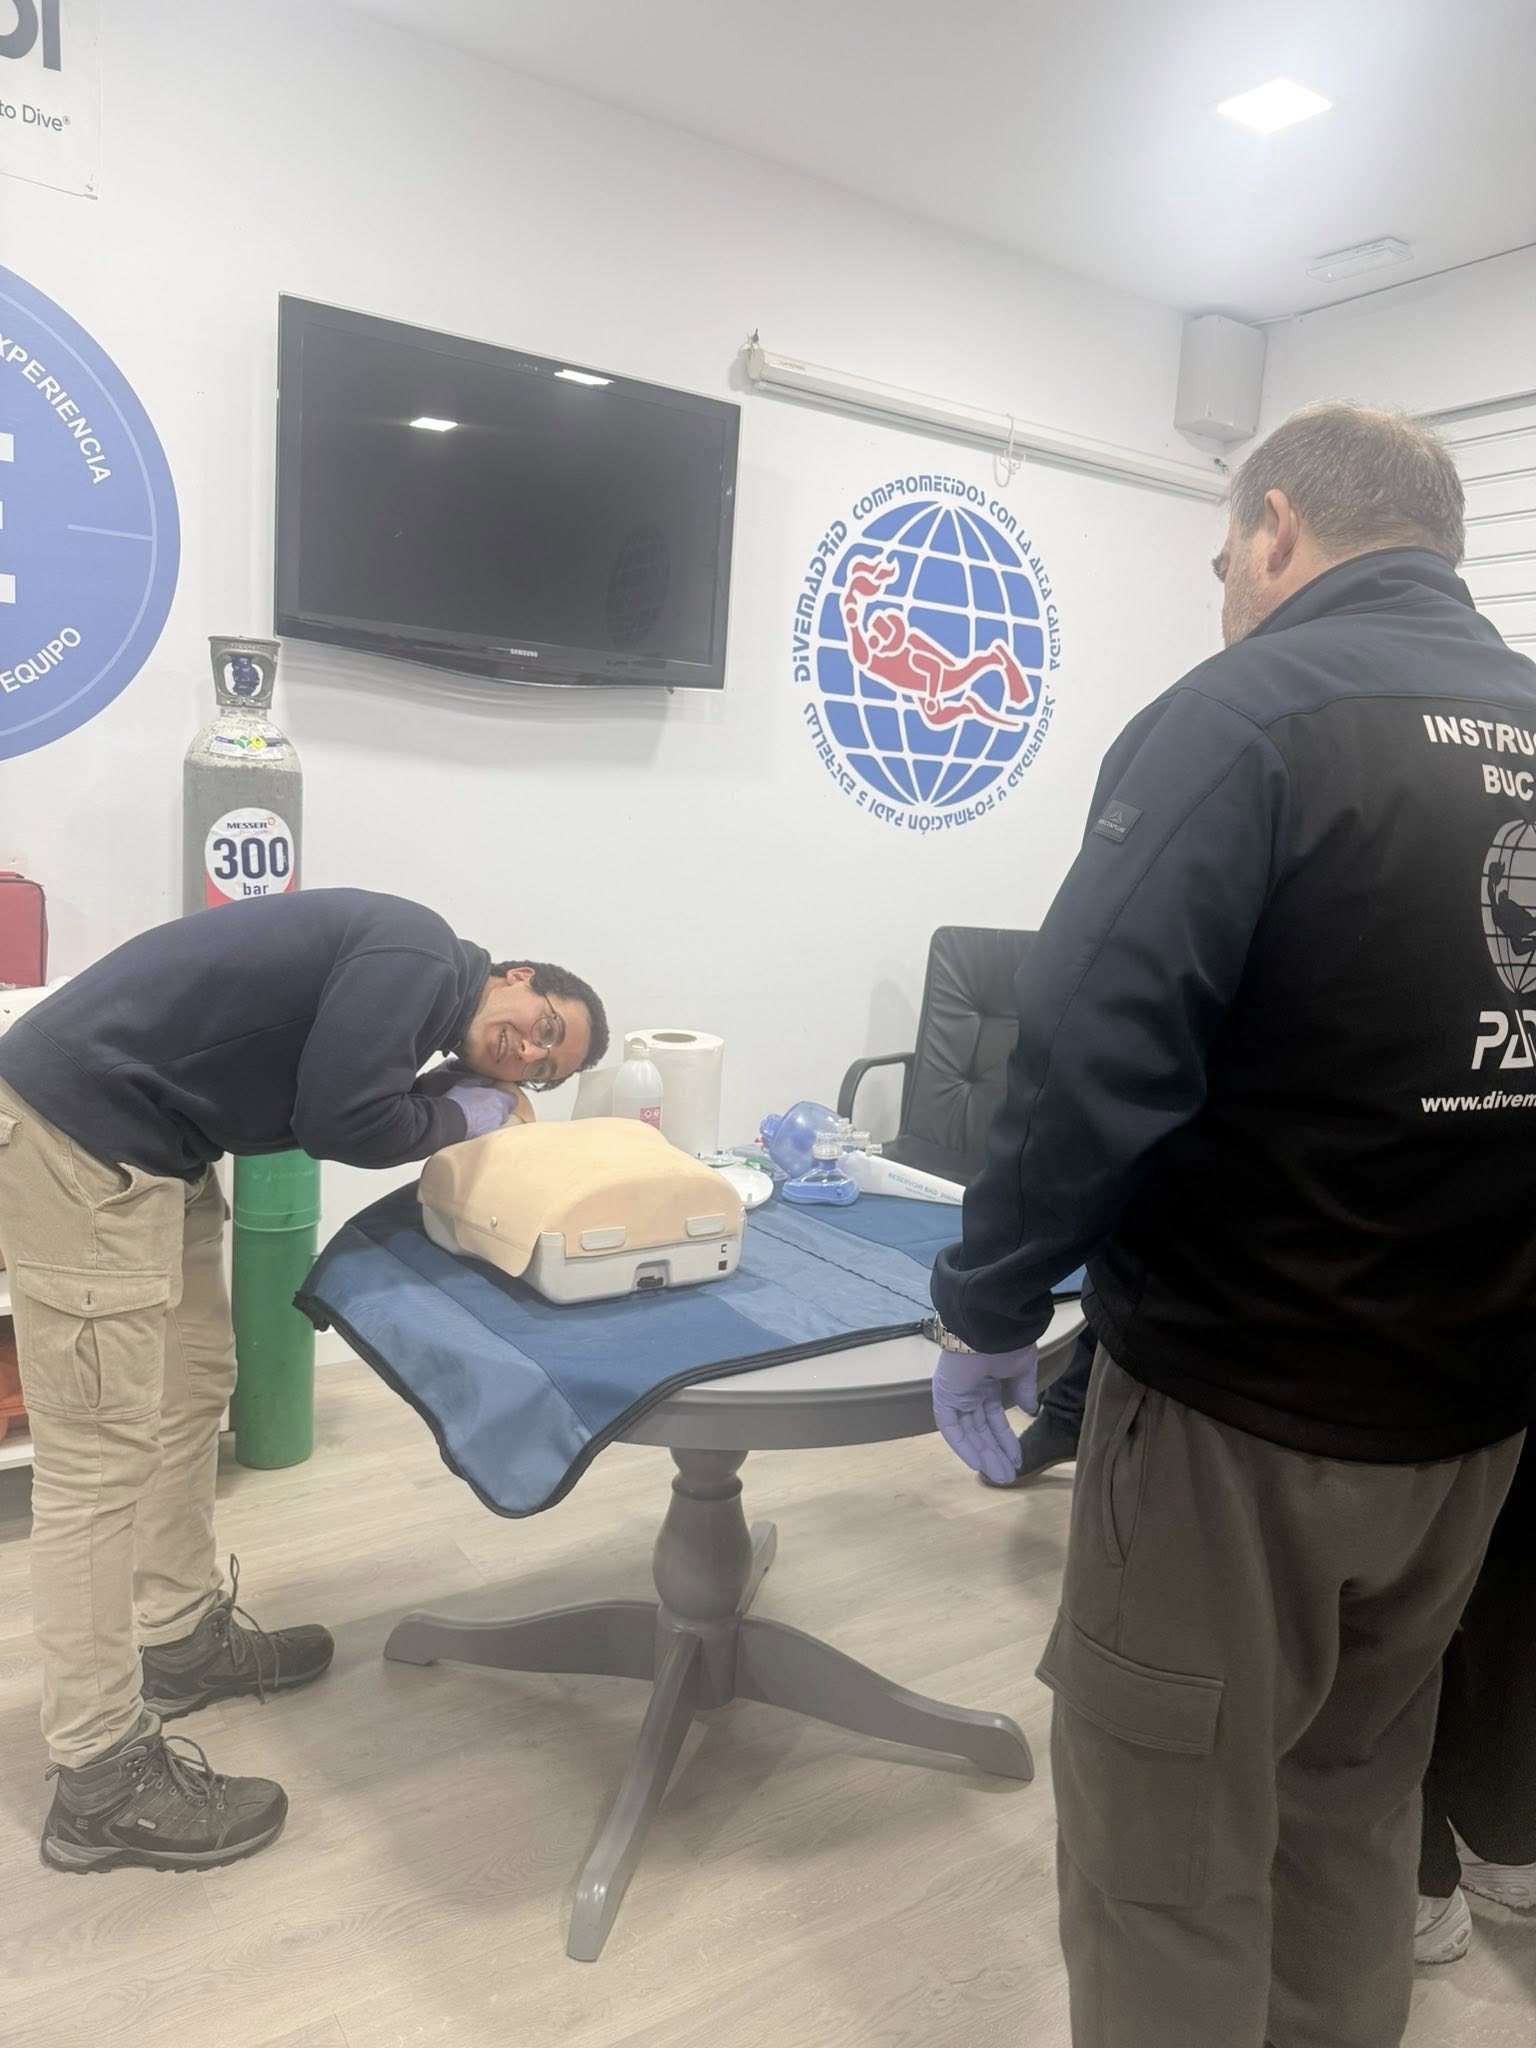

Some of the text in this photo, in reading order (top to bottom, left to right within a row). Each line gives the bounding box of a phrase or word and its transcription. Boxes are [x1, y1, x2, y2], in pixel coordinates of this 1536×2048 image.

[0, 626, 82, 694] EQUIPO
[1422, 713, 1536, 757] INSTRU
[1482, 763, 1535, 802] BUC
[226, 821, 269, 830] MESSER
[868, 798, 904, 828] PADI
[213, 836, 290, 880] 300
[243, 882, 269, 896] bar
